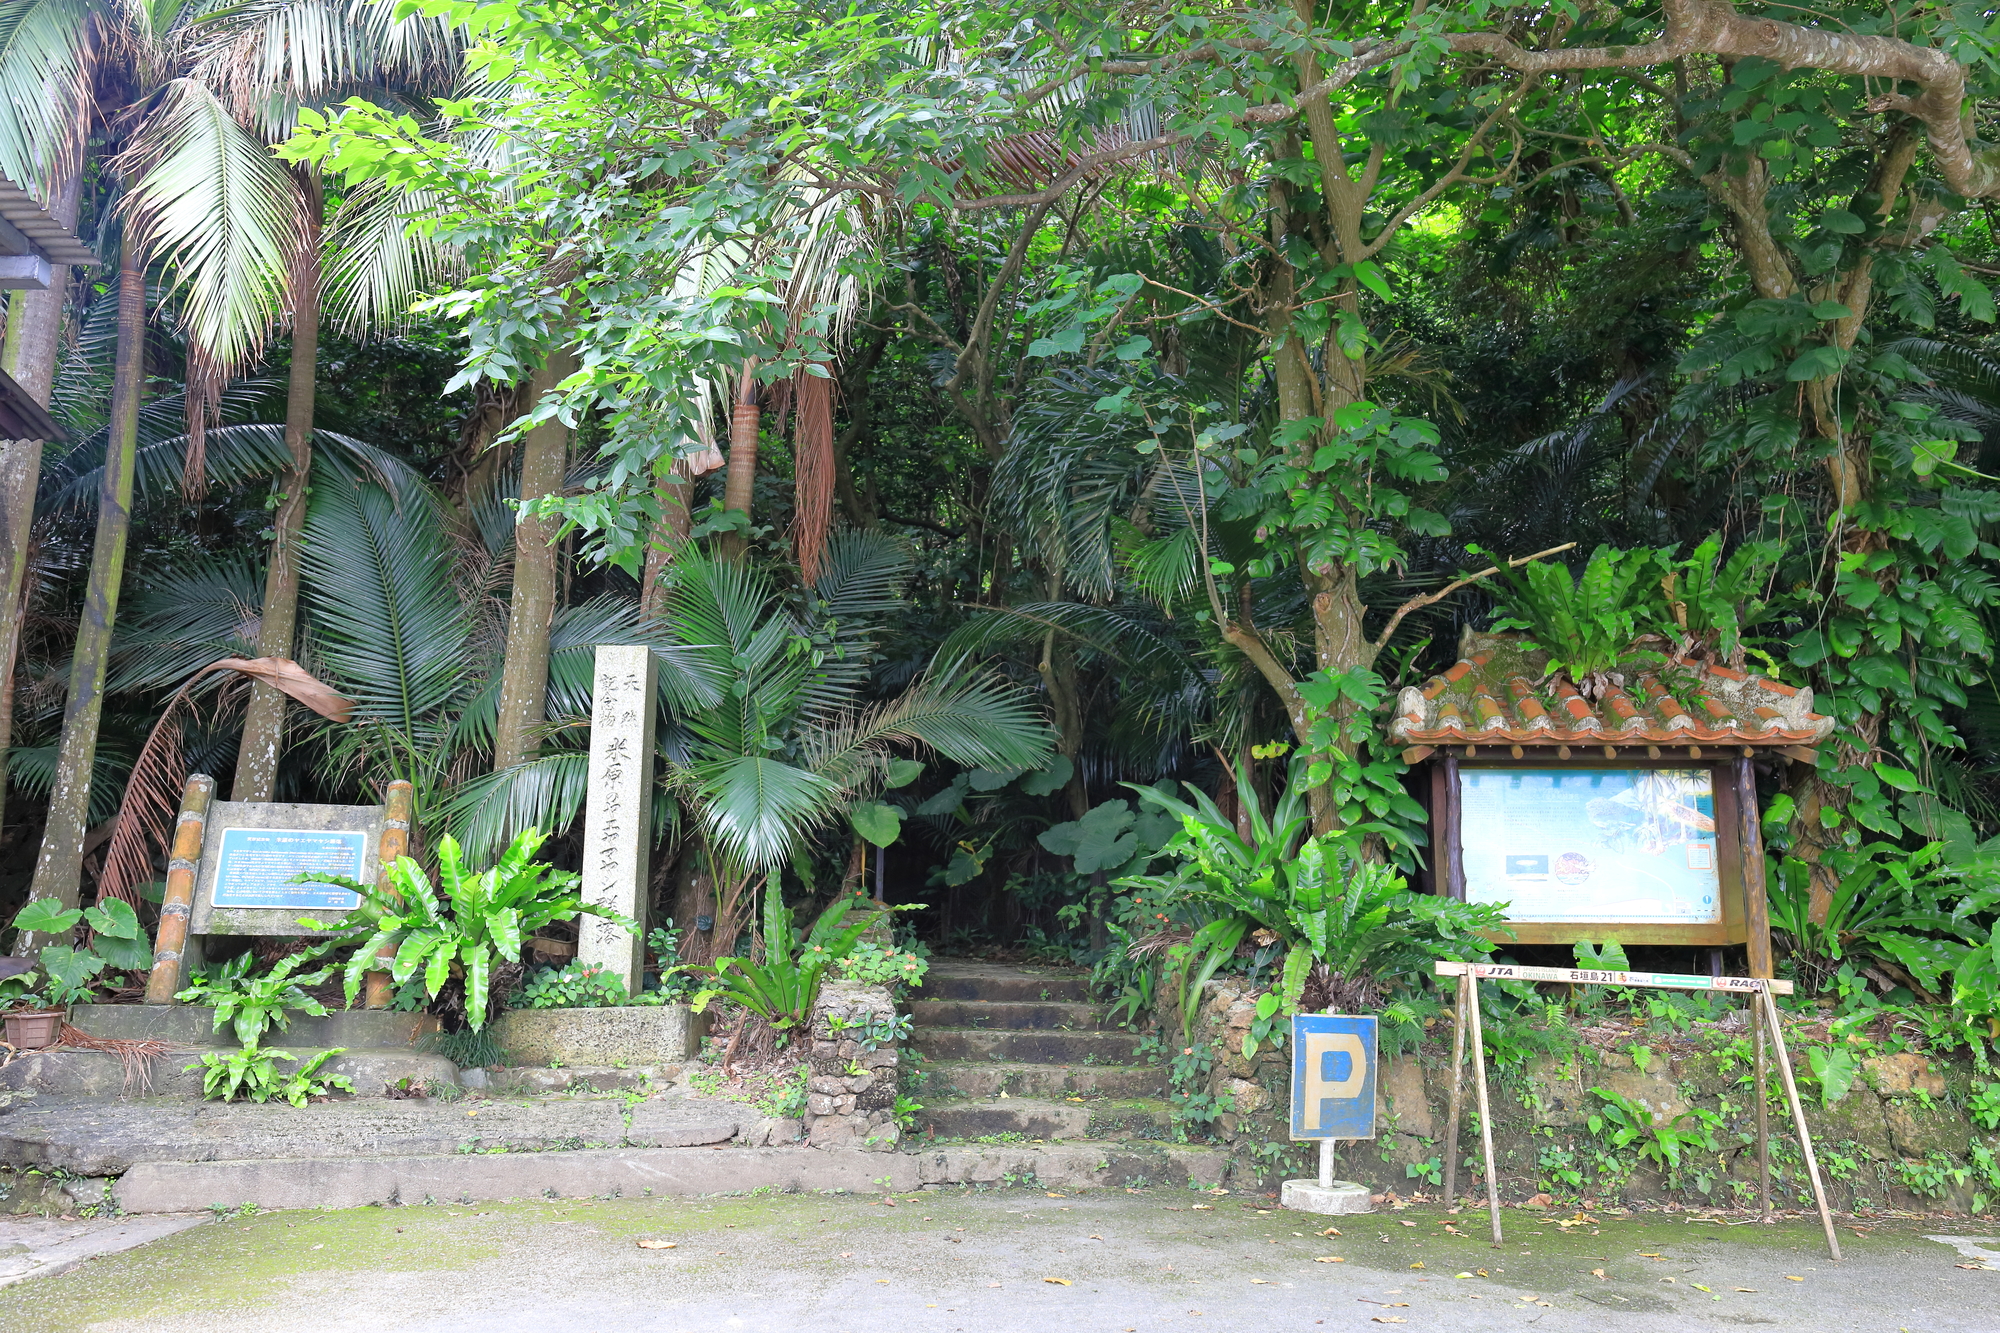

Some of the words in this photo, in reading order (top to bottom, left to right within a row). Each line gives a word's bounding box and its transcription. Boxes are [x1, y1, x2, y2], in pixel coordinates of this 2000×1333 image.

[599, 673, 619, 728] 記念物
[620, 673, 642, 728] 天然
[1488, 967, 1513, 976] JTA
[1522, 971, 1559, 980] OKINAWA
[1304, 1032, 1366, 1130] P
